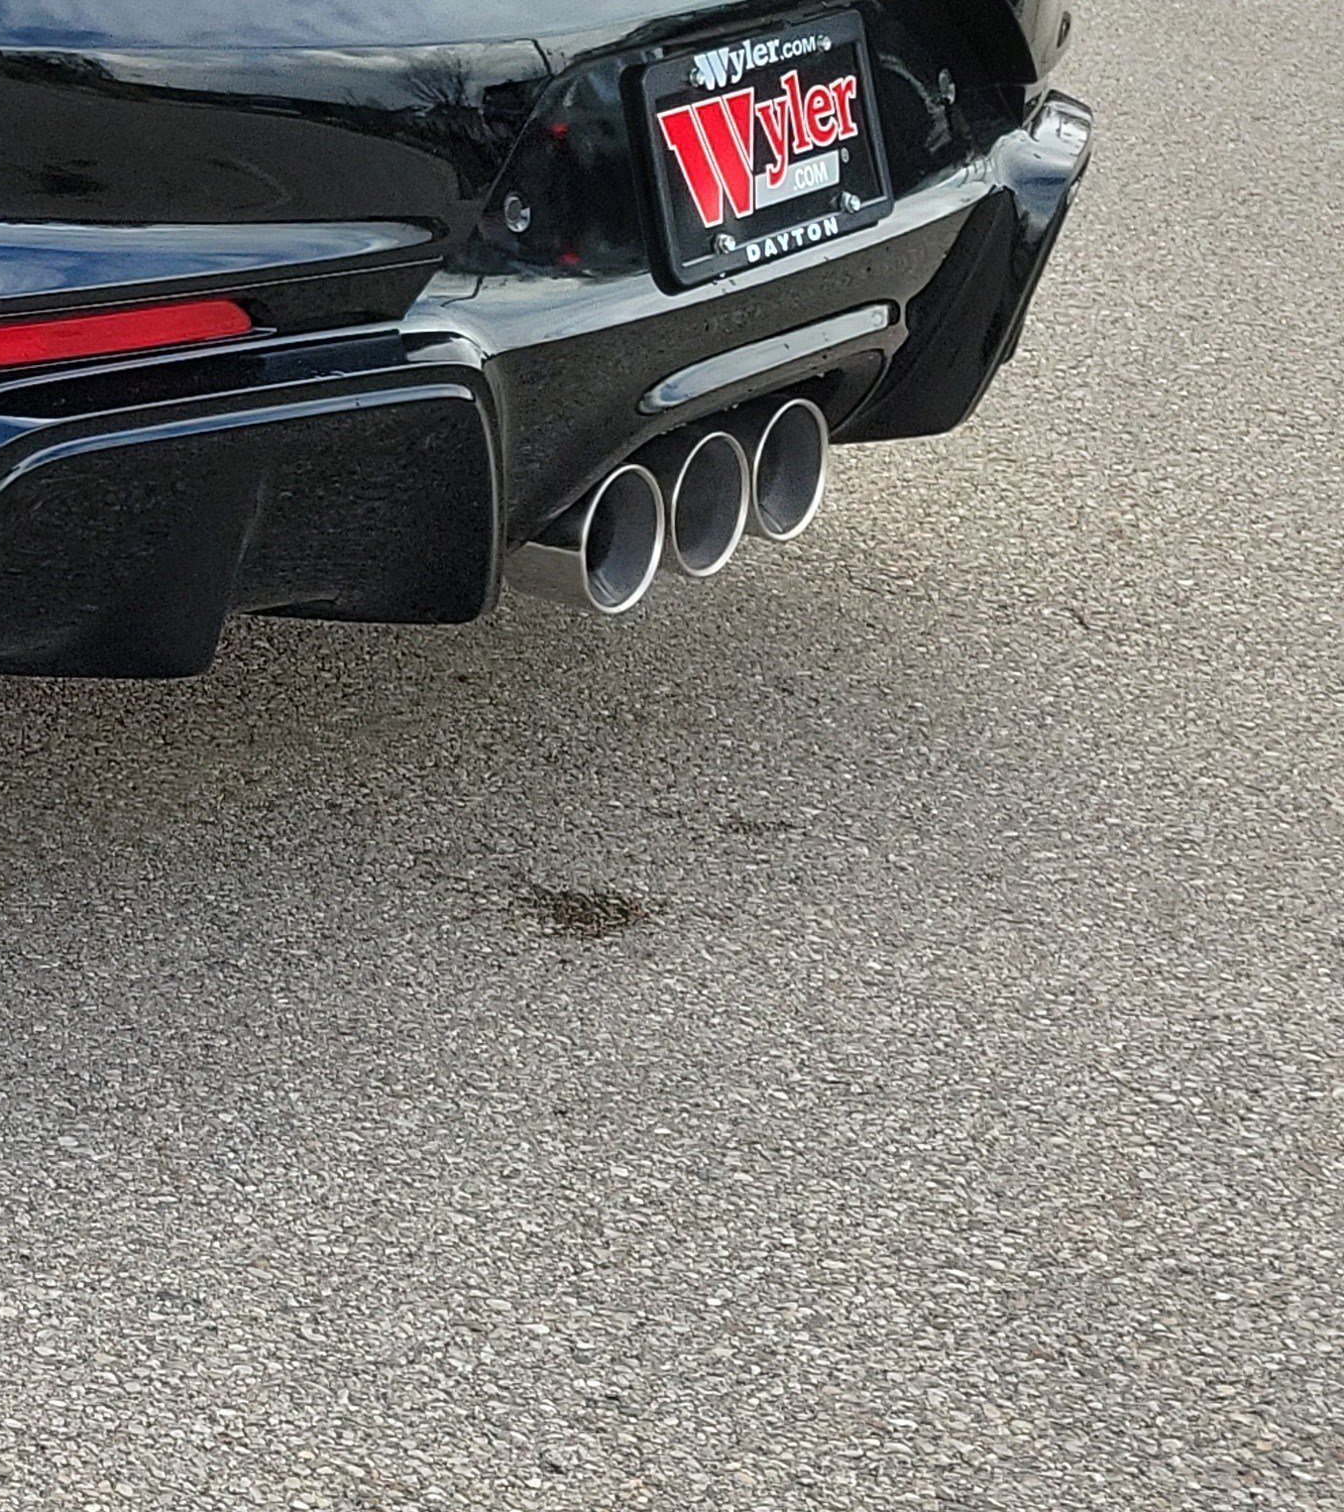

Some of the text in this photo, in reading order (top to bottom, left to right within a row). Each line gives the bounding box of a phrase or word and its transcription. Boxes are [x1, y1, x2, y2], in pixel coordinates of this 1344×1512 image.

[657, 69, 859, 228] Wyler
[793, 161, 830, 191] .COM
[746, 216, 840, 263] DAYTON
